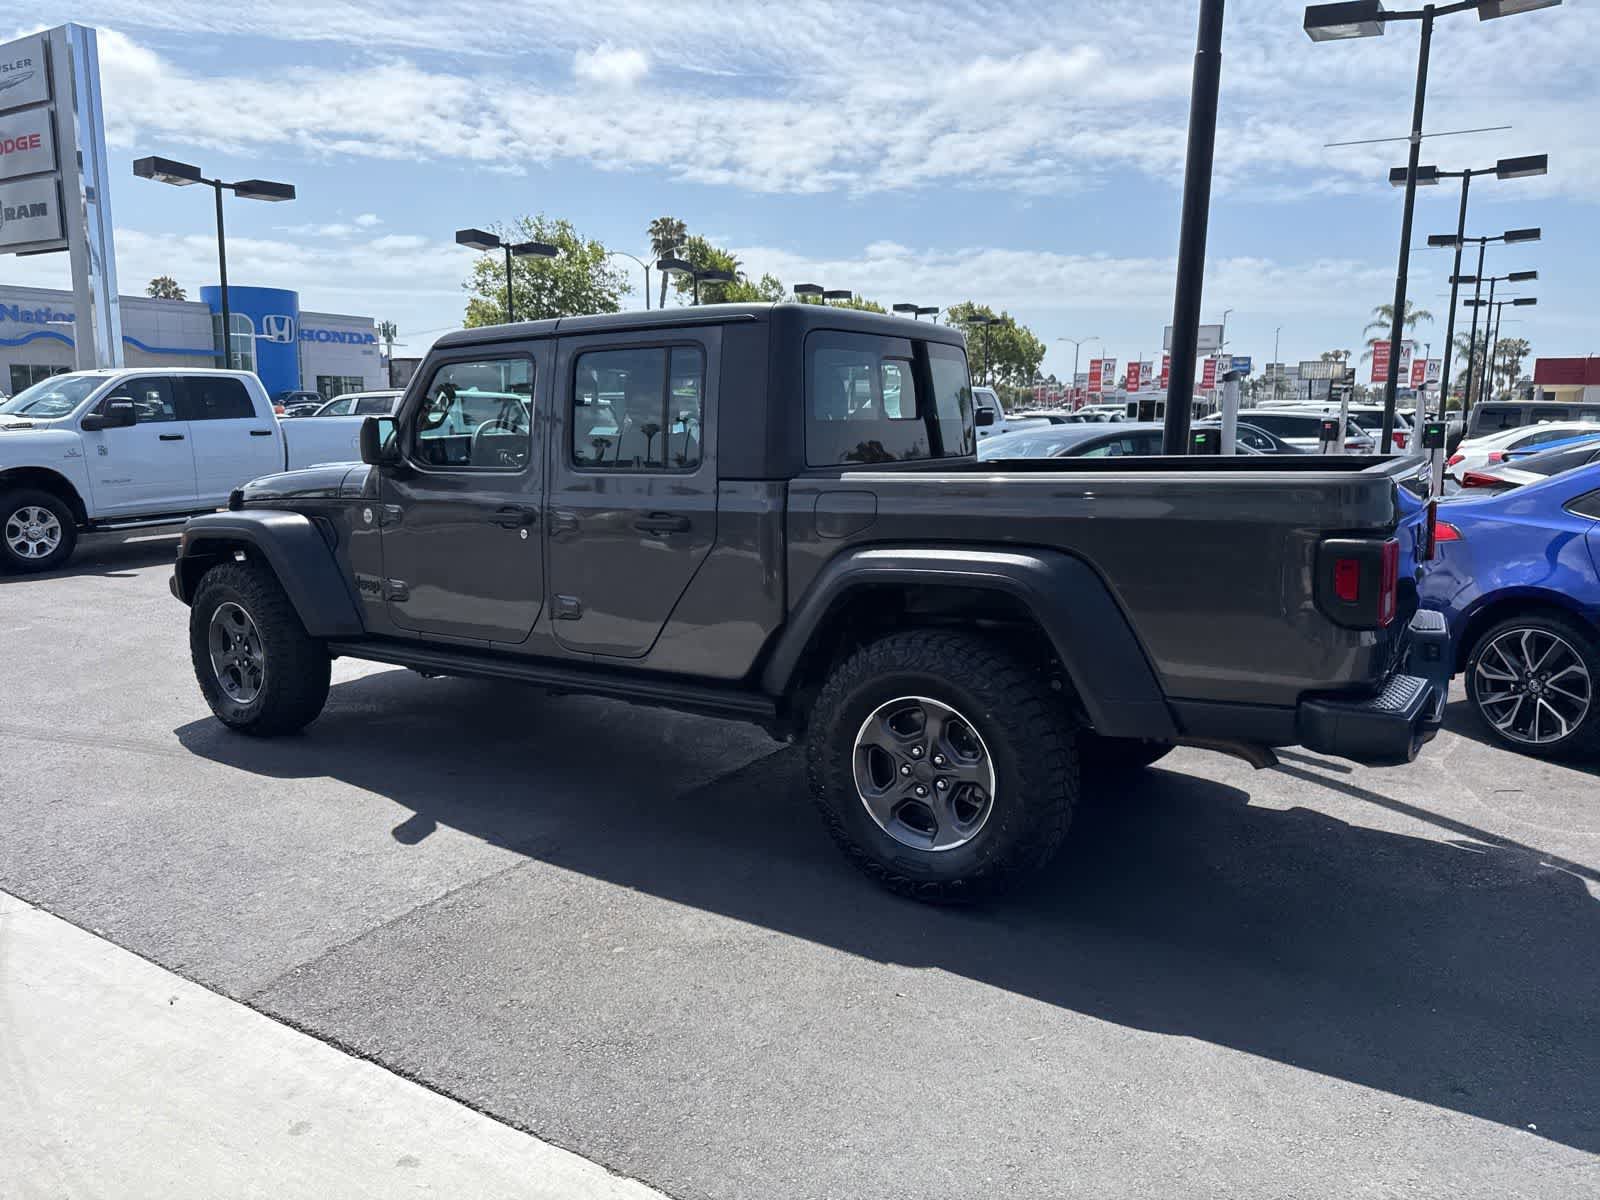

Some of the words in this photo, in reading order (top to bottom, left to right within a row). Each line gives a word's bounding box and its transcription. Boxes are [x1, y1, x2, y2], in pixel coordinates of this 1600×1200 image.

[0, 58, 32, 73] SLER
[4, 203, 47, 221] RAM
[299, 329, 376, 345] HONDA
